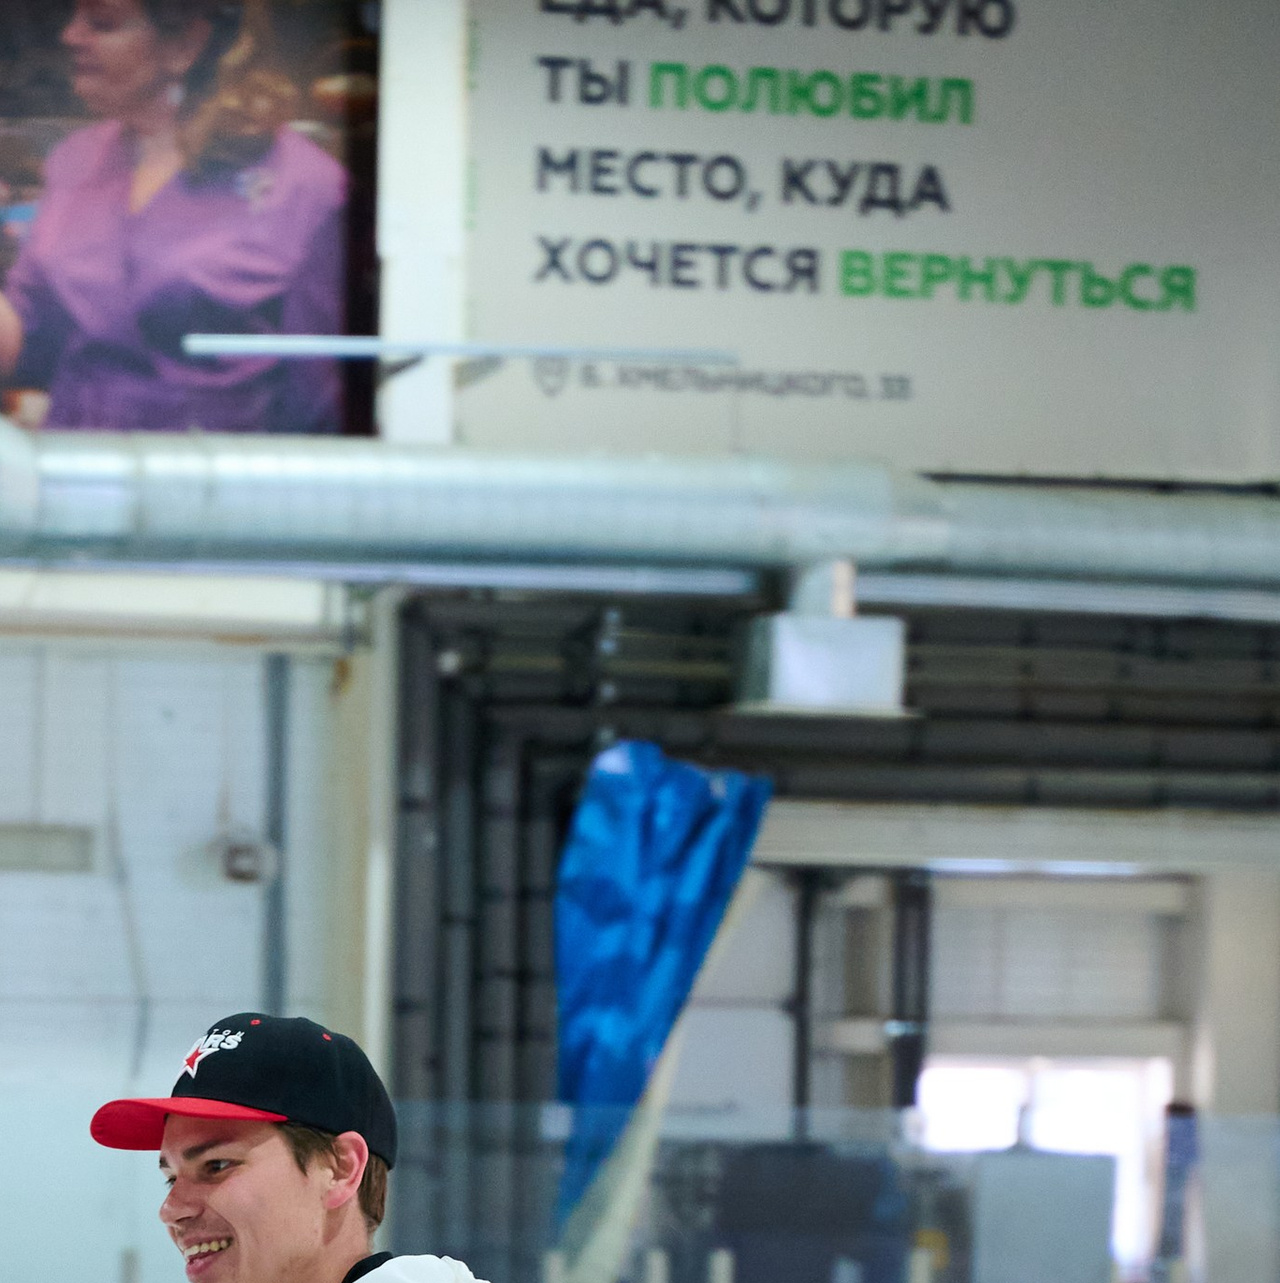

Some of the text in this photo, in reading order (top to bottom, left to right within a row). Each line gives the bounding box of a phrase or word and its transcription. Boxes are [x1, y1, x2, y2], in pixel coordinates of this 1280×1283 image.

[536, 57, 976, 126] ТЫ ПОЛЮБИЛ
[536, 148, 951, 216] МЕСТО, КУДА
[534, 236, 1198, 313] ХОЧЕТСЯ ВЕРНУТЬСЯ
